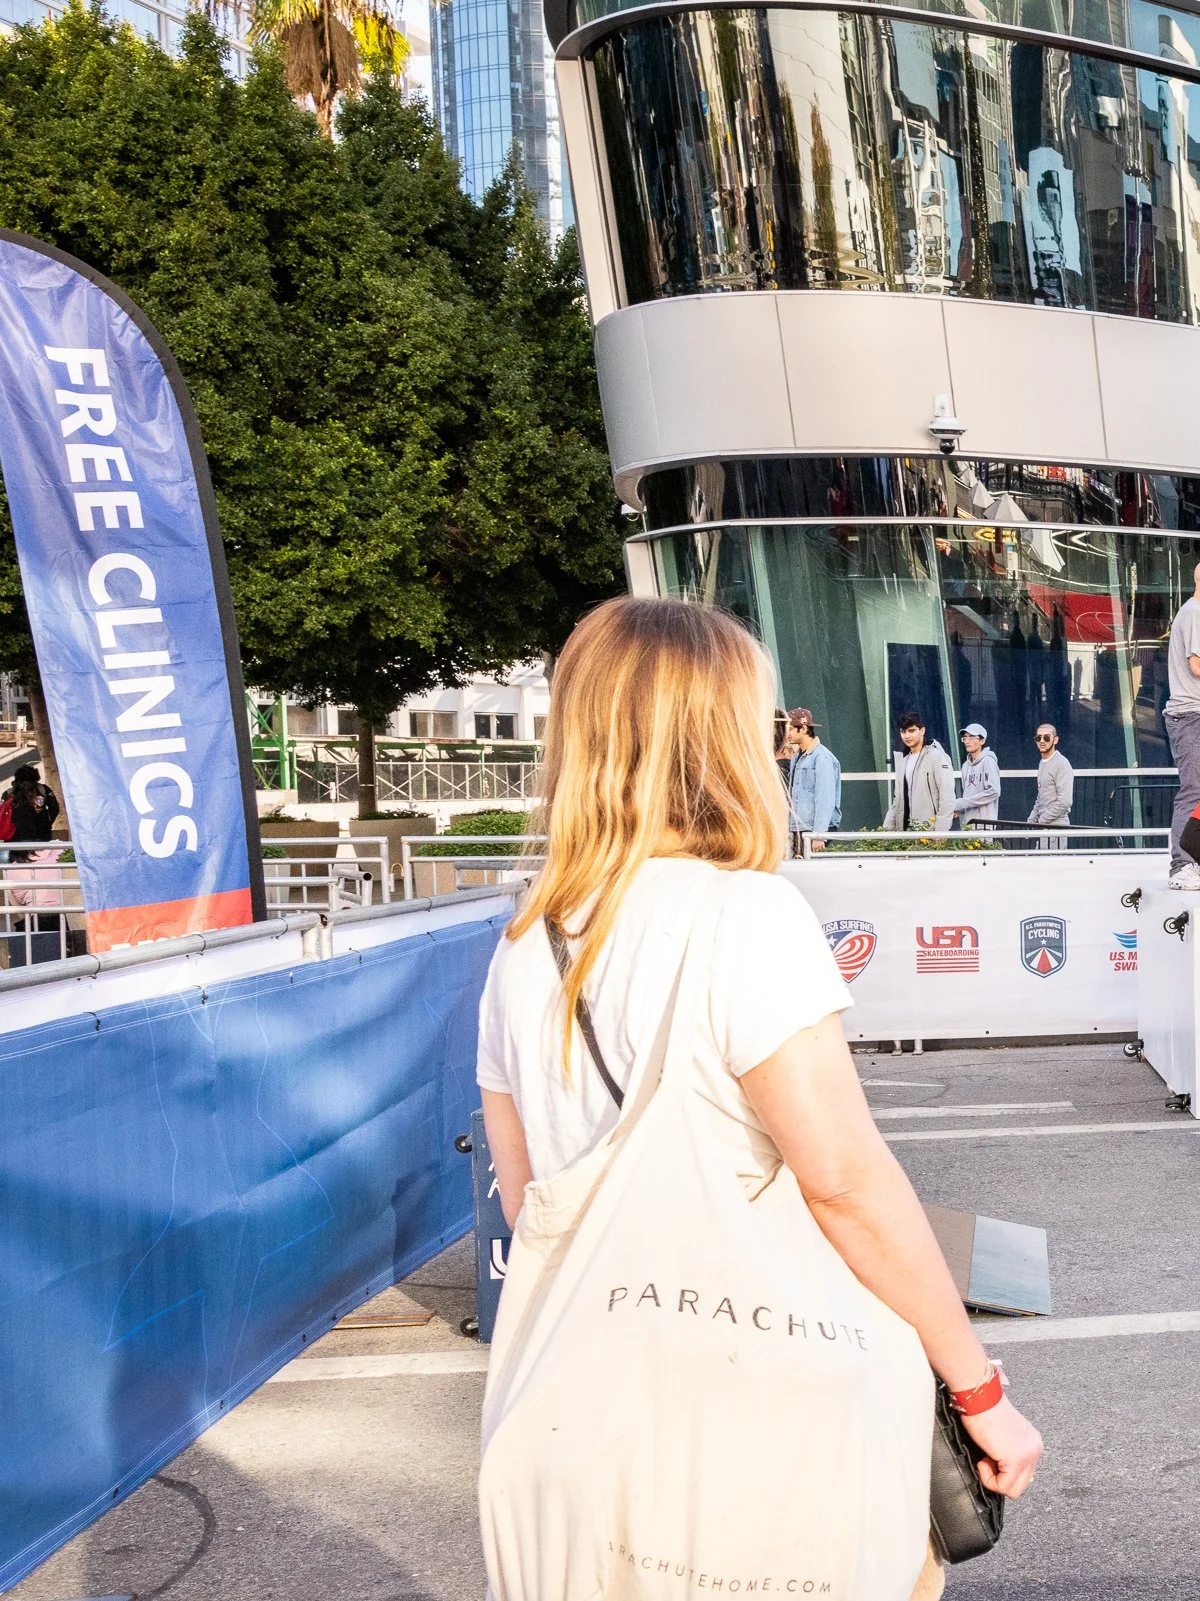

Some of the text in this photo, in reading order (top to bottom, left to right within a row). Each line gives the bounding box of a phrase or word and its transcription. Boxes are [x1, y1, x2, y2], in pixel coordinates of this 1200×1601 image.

[44, 345, 144, 531] FREE
[88, 552, 199, 859] CLINICS
[822, 920, 874, 934] USA SURFING
[1028, 928, 1060, 939] CYCLING
[916, 926, 979, 948] USA
[922, 949, 979, 957] SKATEBOARDING
[1109, 951, 1126, 961] U.S.
[608, 1283, 868, 1351] PARACHUTE
